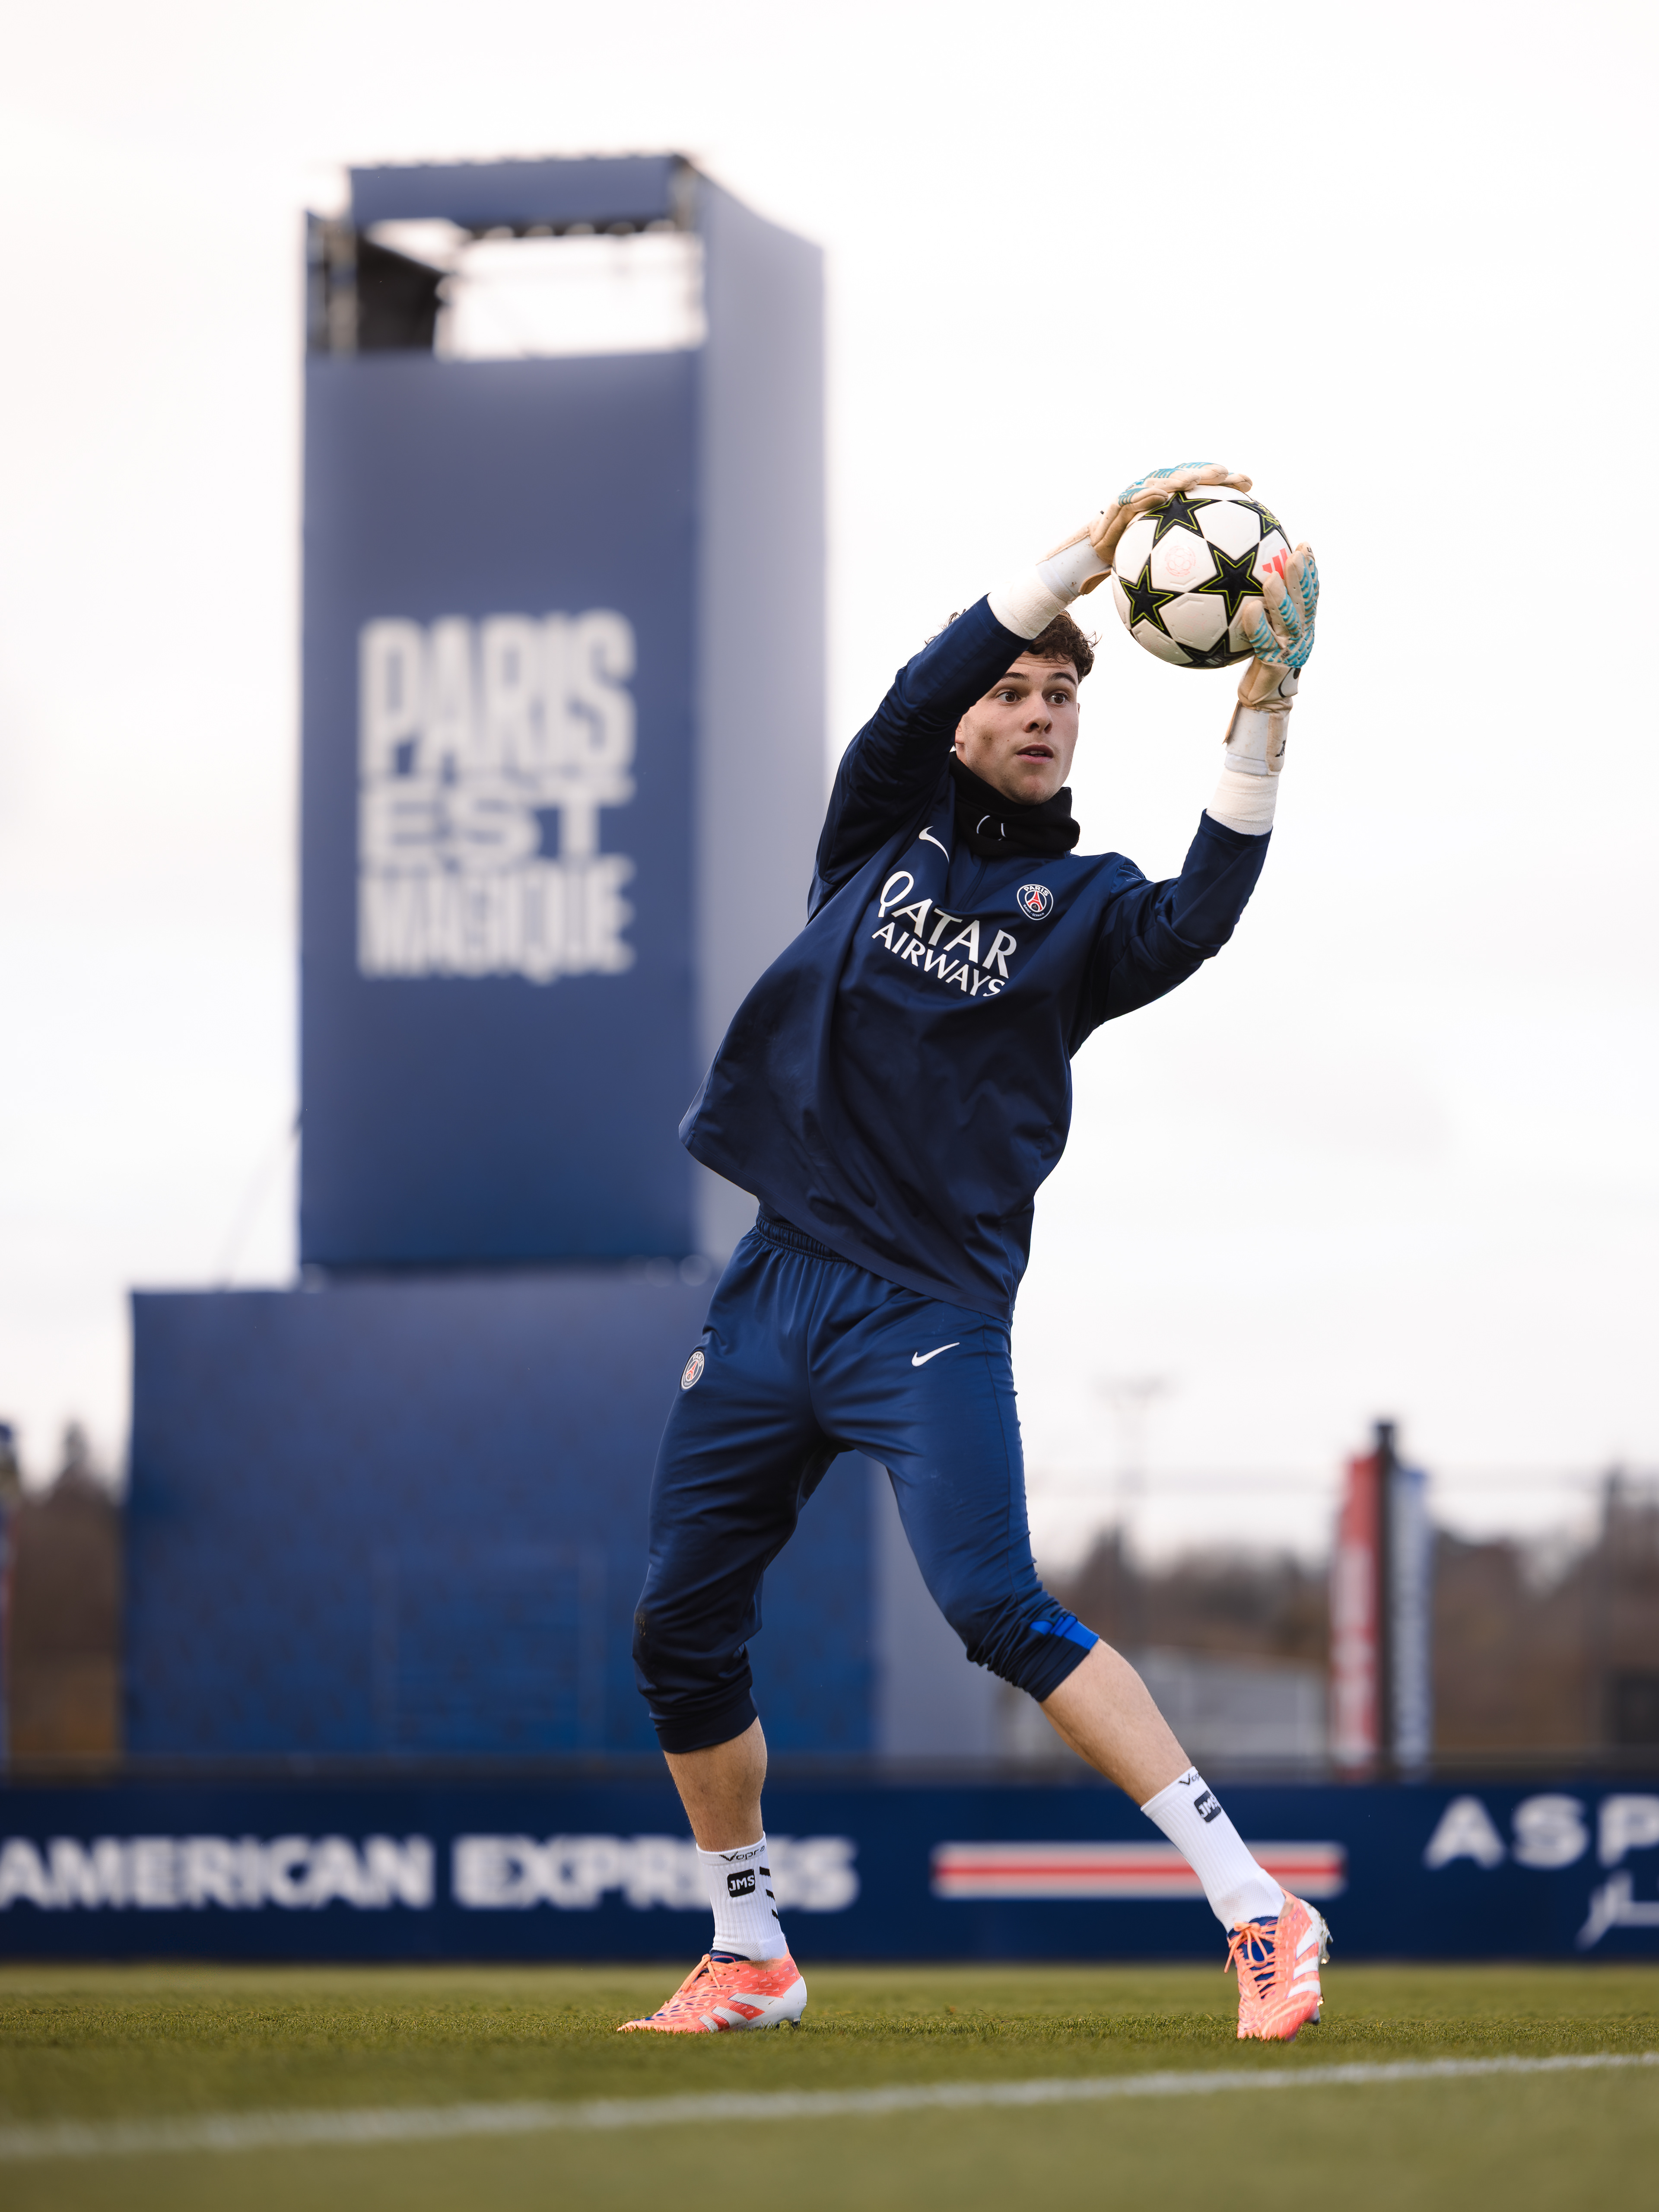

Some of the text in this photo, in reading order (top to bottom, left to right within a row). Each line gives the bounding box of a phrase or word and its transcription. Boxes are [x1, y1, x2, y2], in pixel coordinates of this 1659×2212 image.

[359, 612, 637, 777] PARIS
[359, 777, 635, 867] EST
[878, 871, 1017, 979] QATAR
[1023, 886, 1049, 896] PARIS
[871, 922, 1006, 997] AIRWAYS
[0, 1835, 435, 1908] AMERICAN
[728, 1875, 755, 1891] JMS
